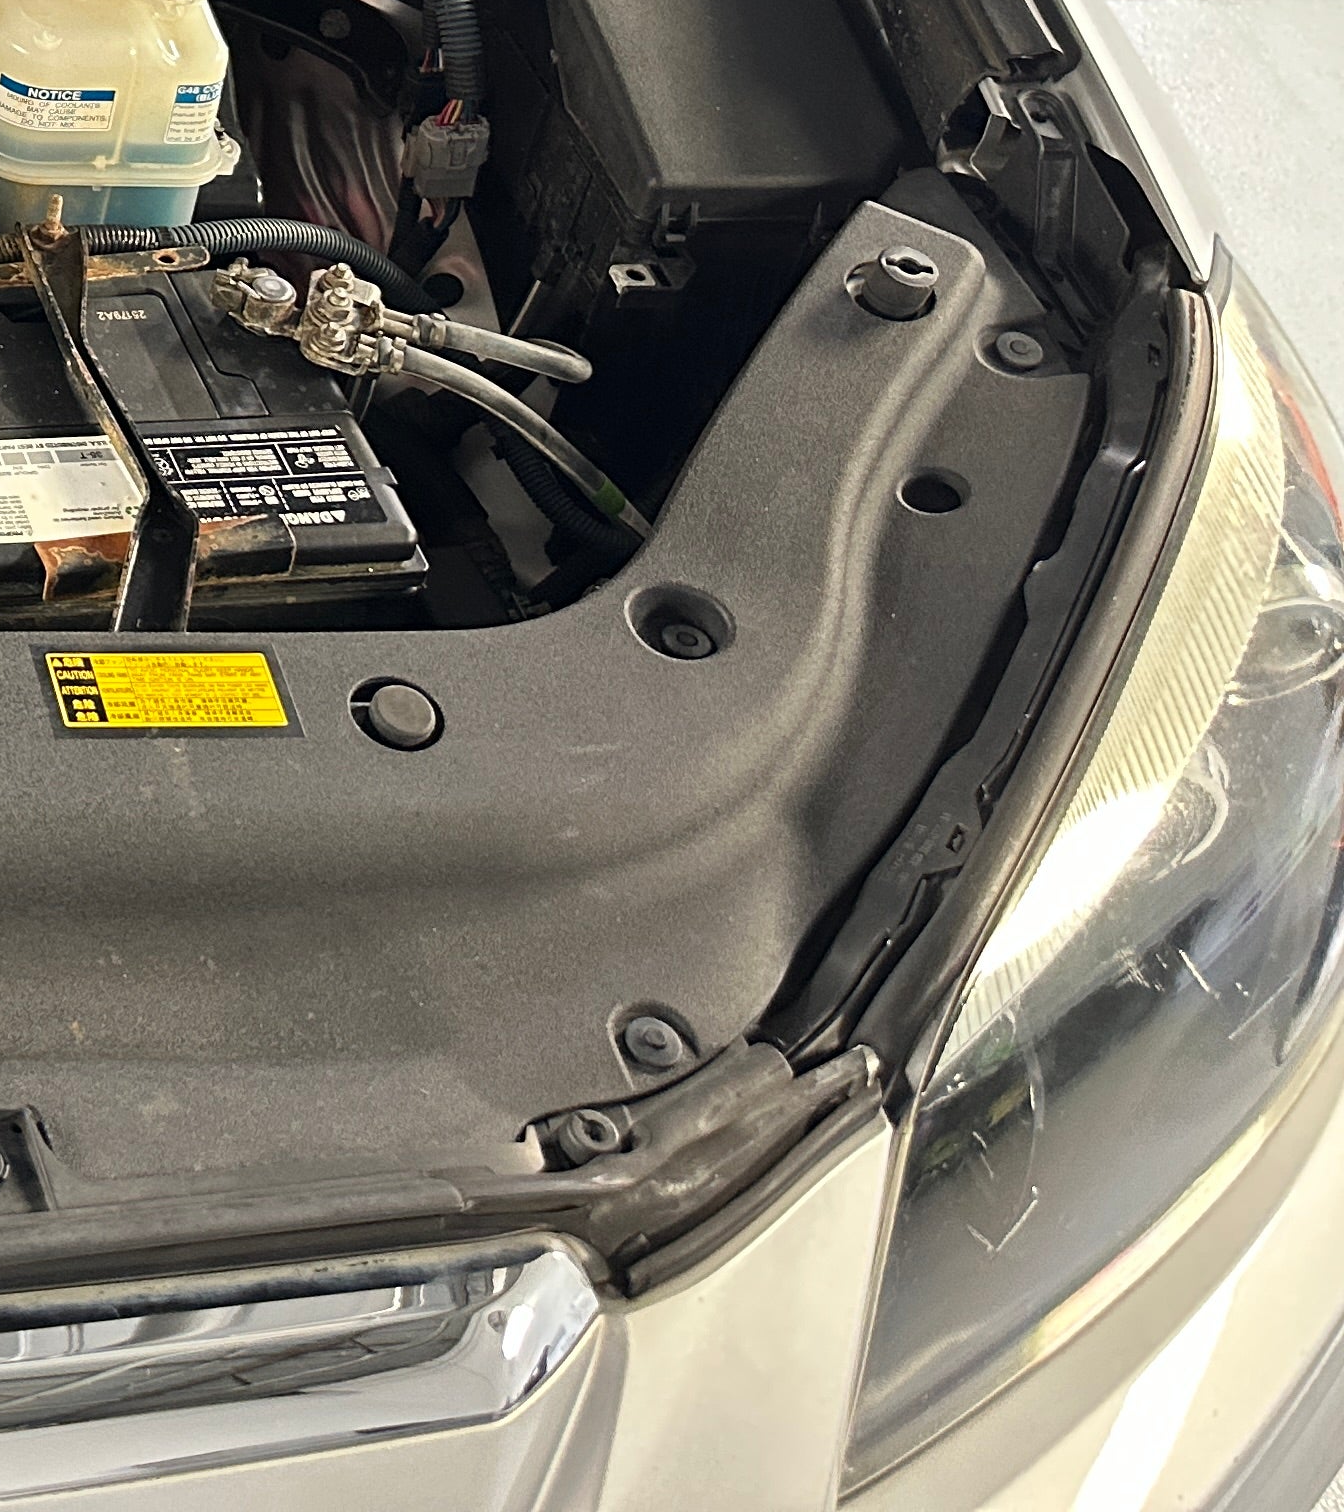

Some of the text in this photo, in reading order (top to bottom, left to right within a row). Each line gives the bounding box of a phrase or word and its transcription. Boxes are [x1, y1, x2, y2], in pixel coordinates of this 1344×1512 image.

[28, 88, 82, 100] NOTICE
[278, 511, 331, 526] DANG
[56, 670, 94, 680] CAUTION
[61, 686, 99, 695] ATTENTION
